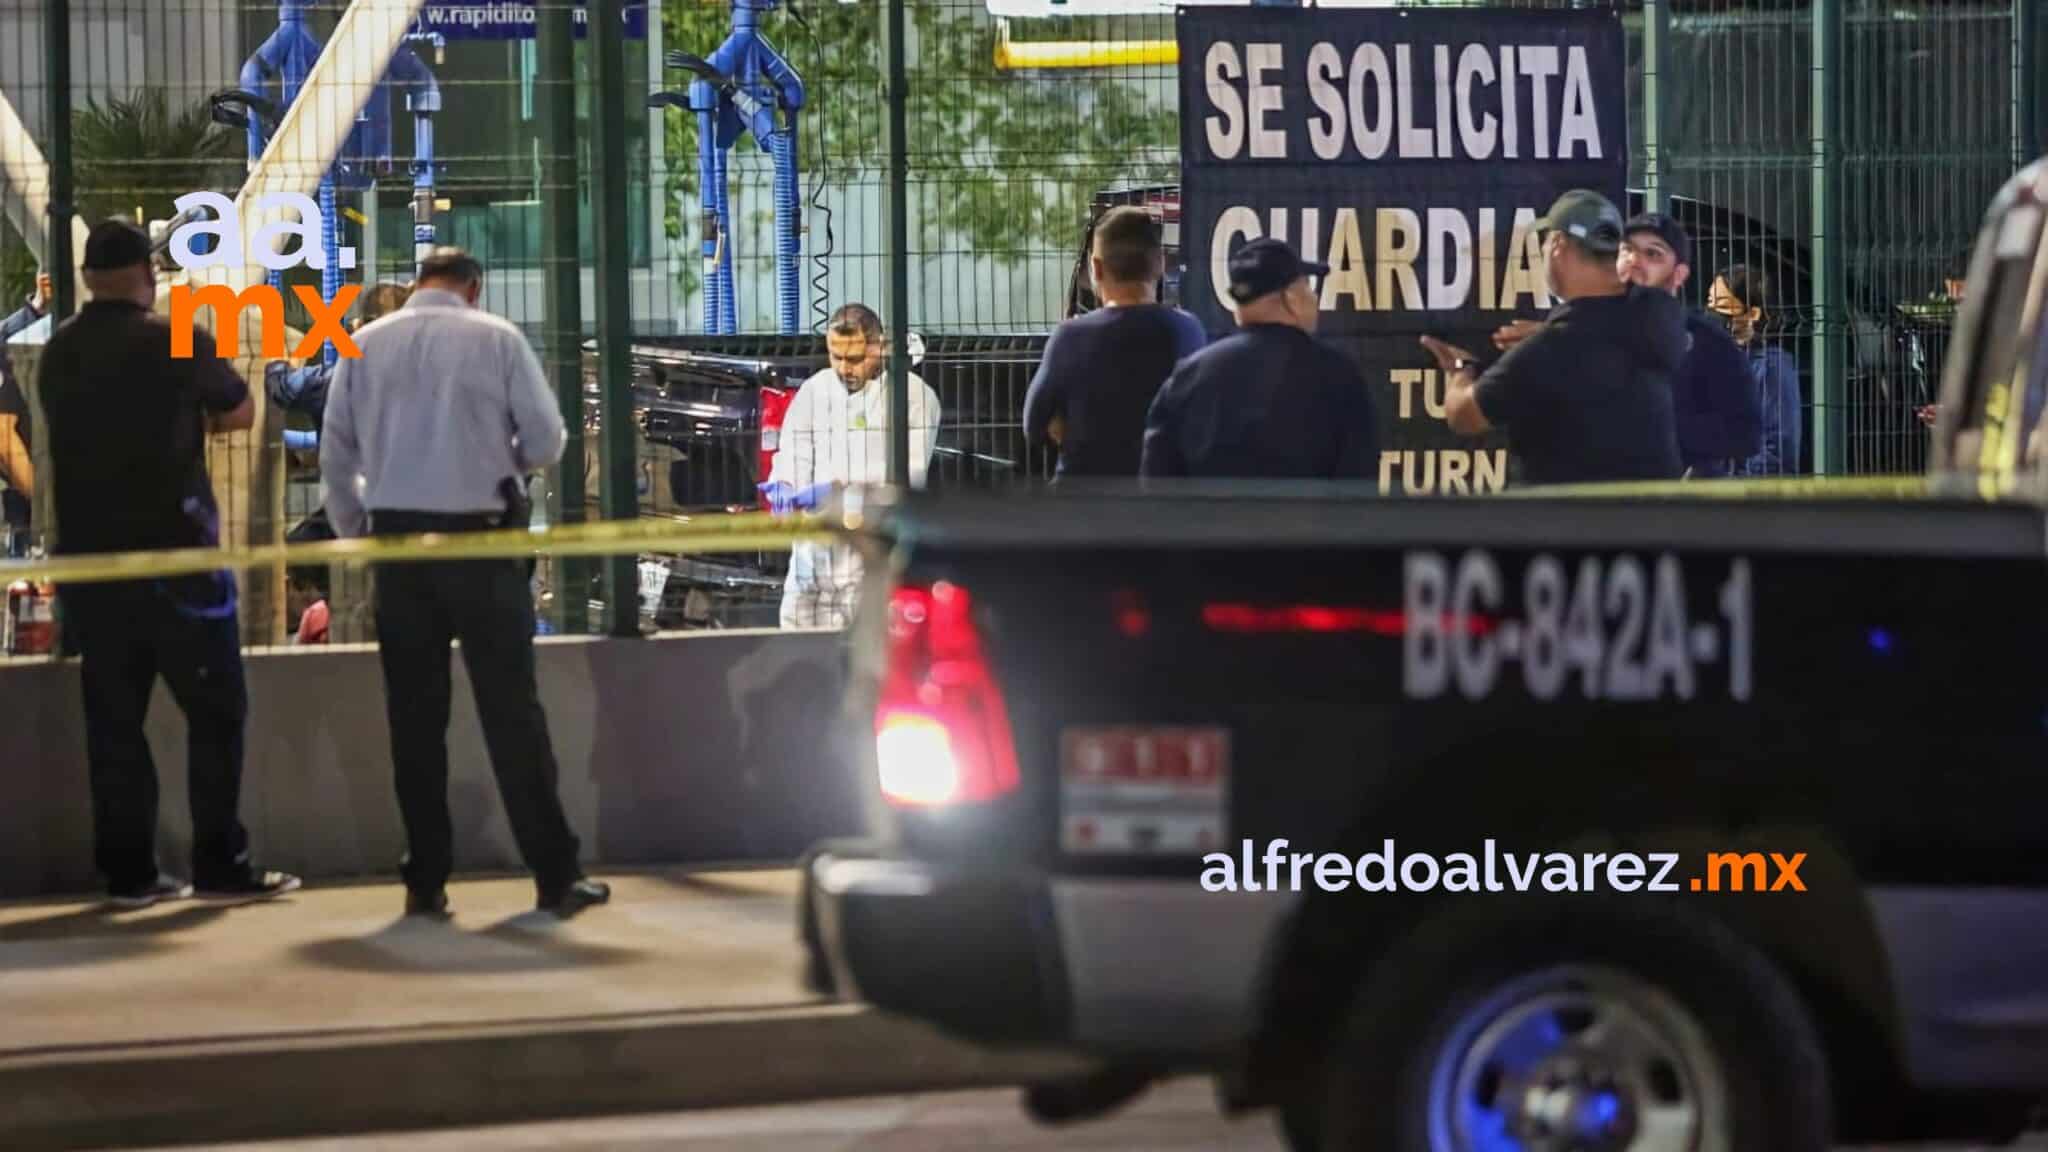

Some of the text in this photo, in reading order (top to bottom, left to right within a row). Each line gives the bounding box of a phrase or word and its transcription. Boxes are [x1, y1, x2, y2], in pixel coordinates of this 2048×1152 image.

[1205, 41, 1603, 160] SE SOLICITA
[1210, 206, 1562, 316] GARDIA
[1390, 369, 1450, 419] TU
[1378, 450, 1507, 496] TURN
[1402, 549, 1752, 700] BC-842A-1
